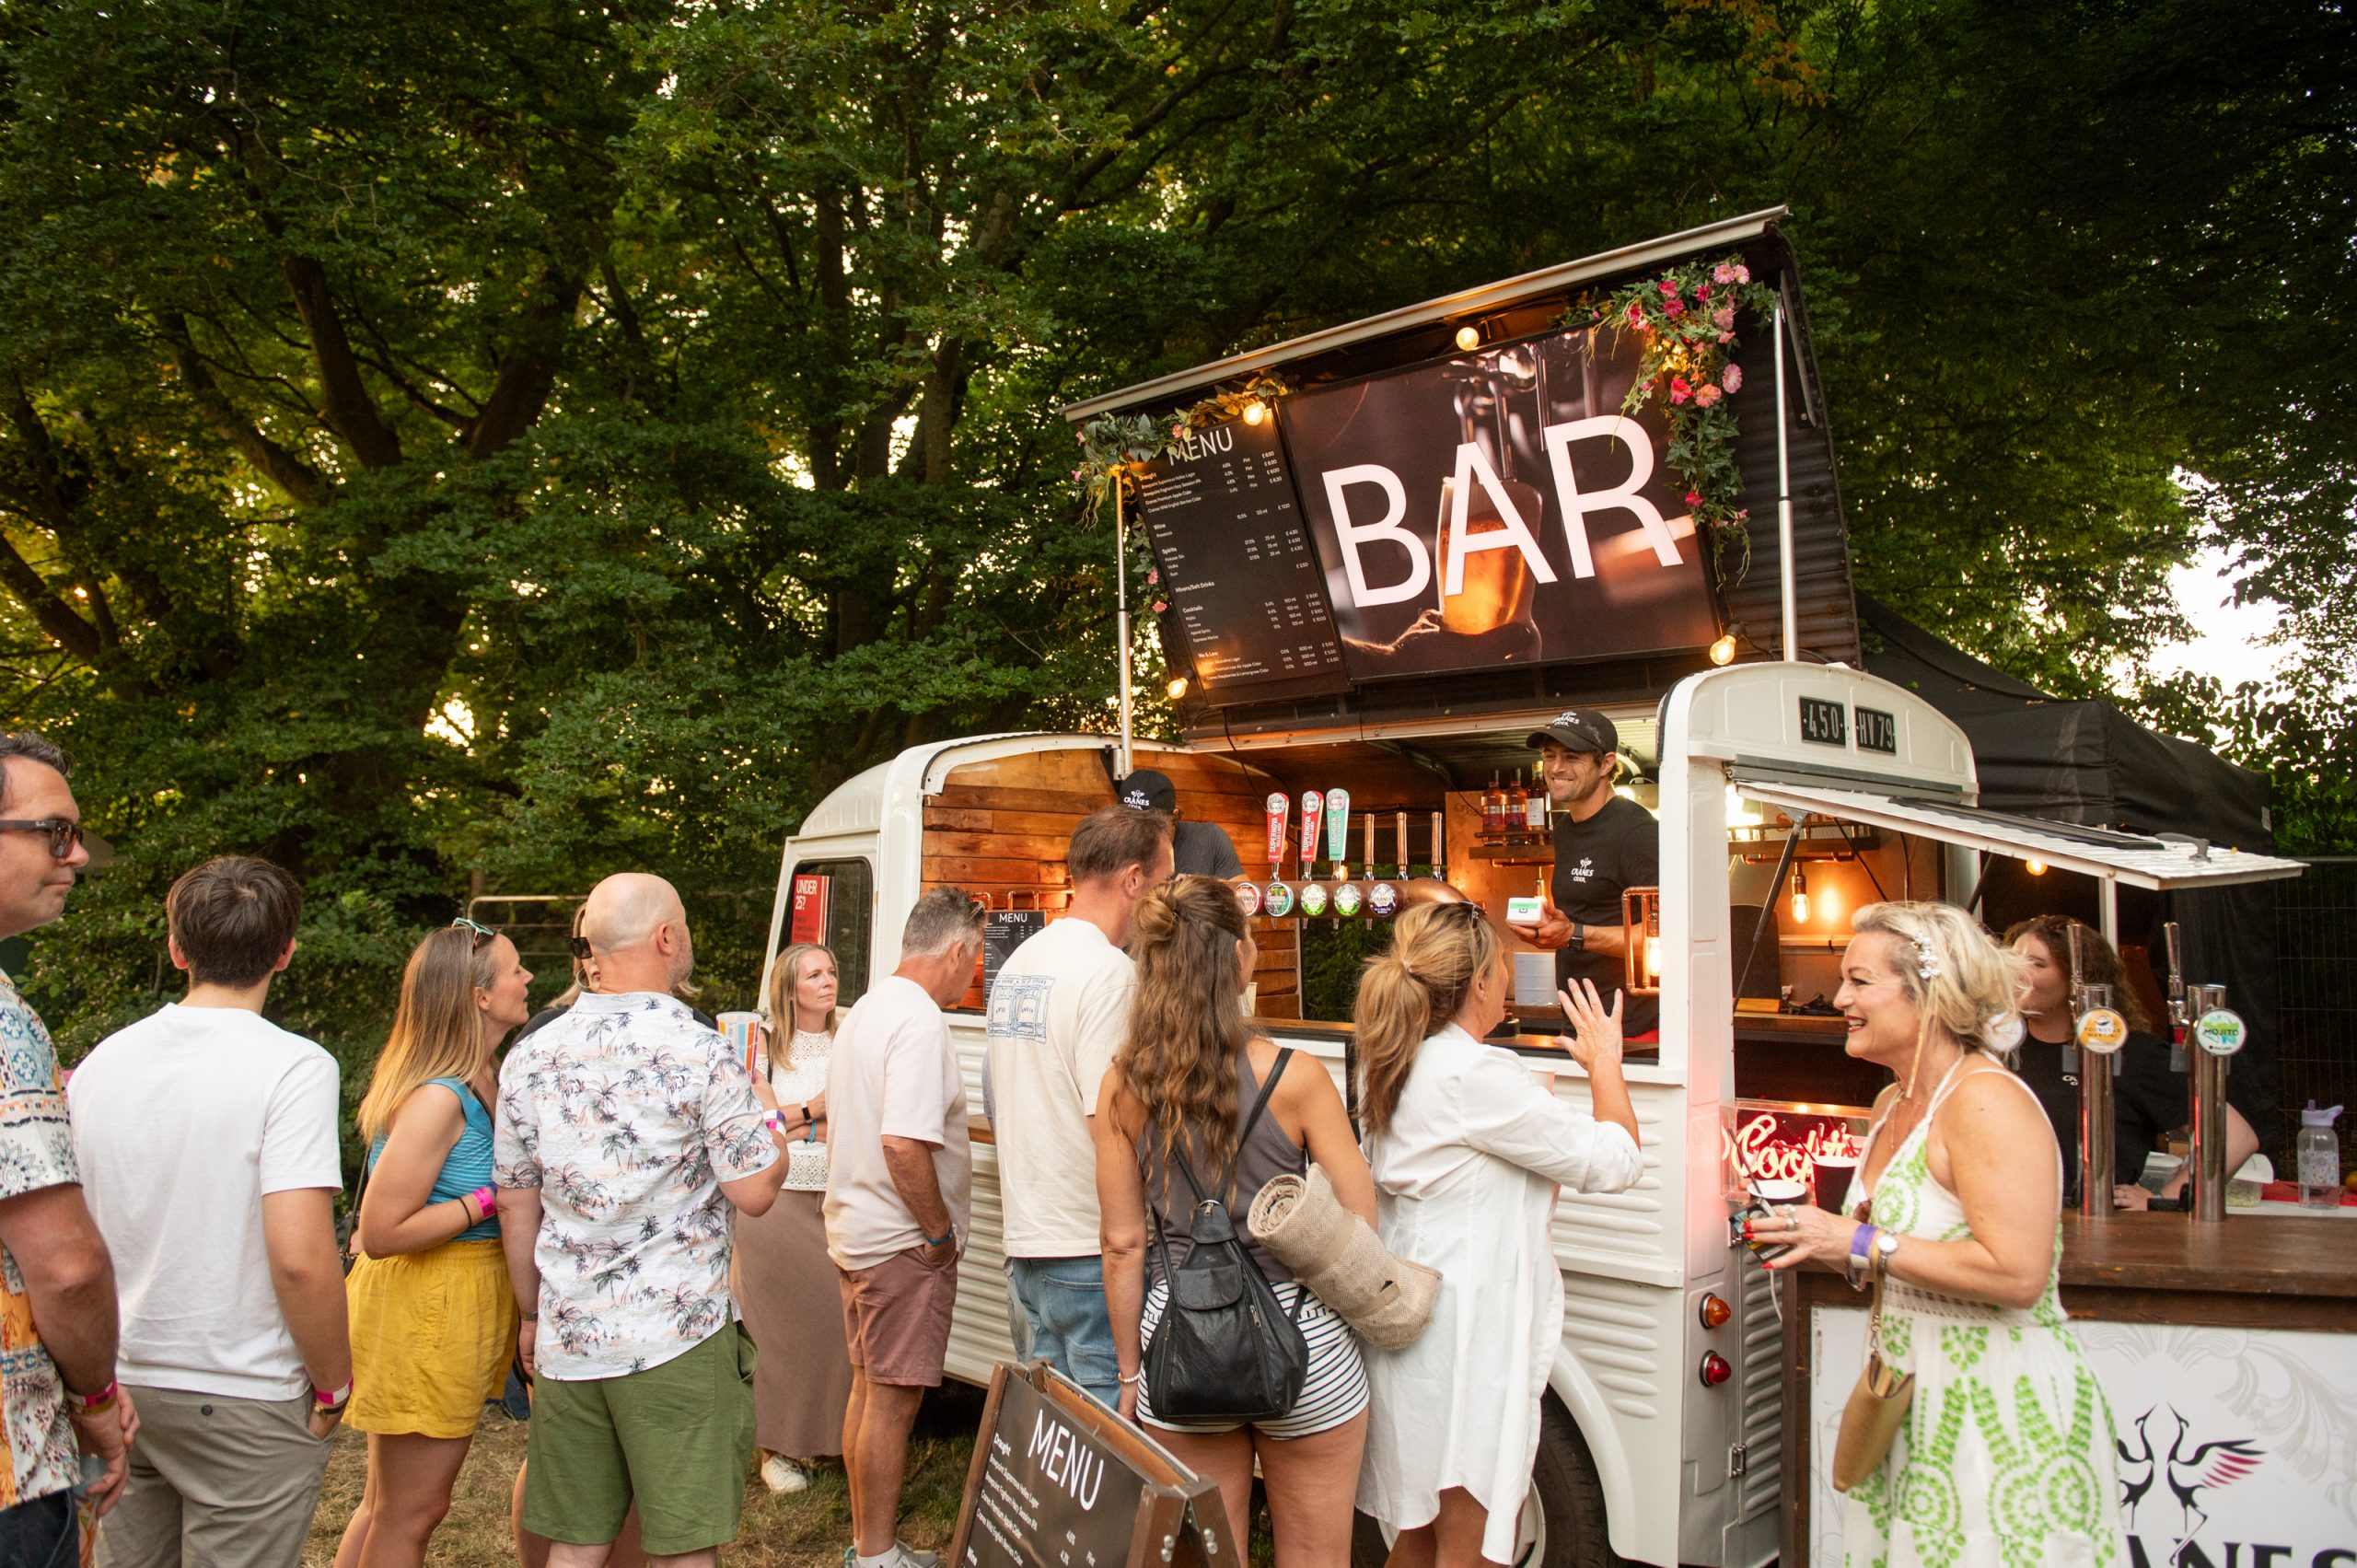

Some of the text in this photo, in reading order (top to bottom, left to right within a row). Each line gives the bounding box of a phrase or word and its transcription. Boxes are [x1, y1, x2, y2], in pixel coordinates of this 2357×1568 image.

[1169, 427, 1233, 466] MENU
[1139, 472, 1156, 482] Draught
[1322, 414, 1684, 608] BAR
[1182, 605, 1203, 613] Cocktails
[1809, 703, 1839, 739] 450
[1858, 712, 1893, 749] HV 79
[1124, 796, 1150, 806] CRANES
[1270, 817, 1278, 853] SUPERNOVA
[1303, 816, 1311, 852] SUPERNOVA
[796, 879, 818, 895] UNDER
[1571, 867, 1594, 877] CRANES
[795, 896, 806, 911] 25?
[999, 912, 1028, 923] MENU
[993, 1433, 1011, 1457] Draught
[1028, 1409, 1104, 1511] MENU
[981, 1490, 1022, 1539] Cranes Premium Apple Cider
[1028, 1493, 1039, 1508] Lager
[1086, 1551, 1096, 1567] Pint
[977, 1508, 987, 1526] Cranes
[992, 1527, 1003, 1544] English
[1002, 1538, 1014, 1557] Berries
[1013, 1551, 1023, 1566] Cider
[967, 1545, 978, 1566] Wine
